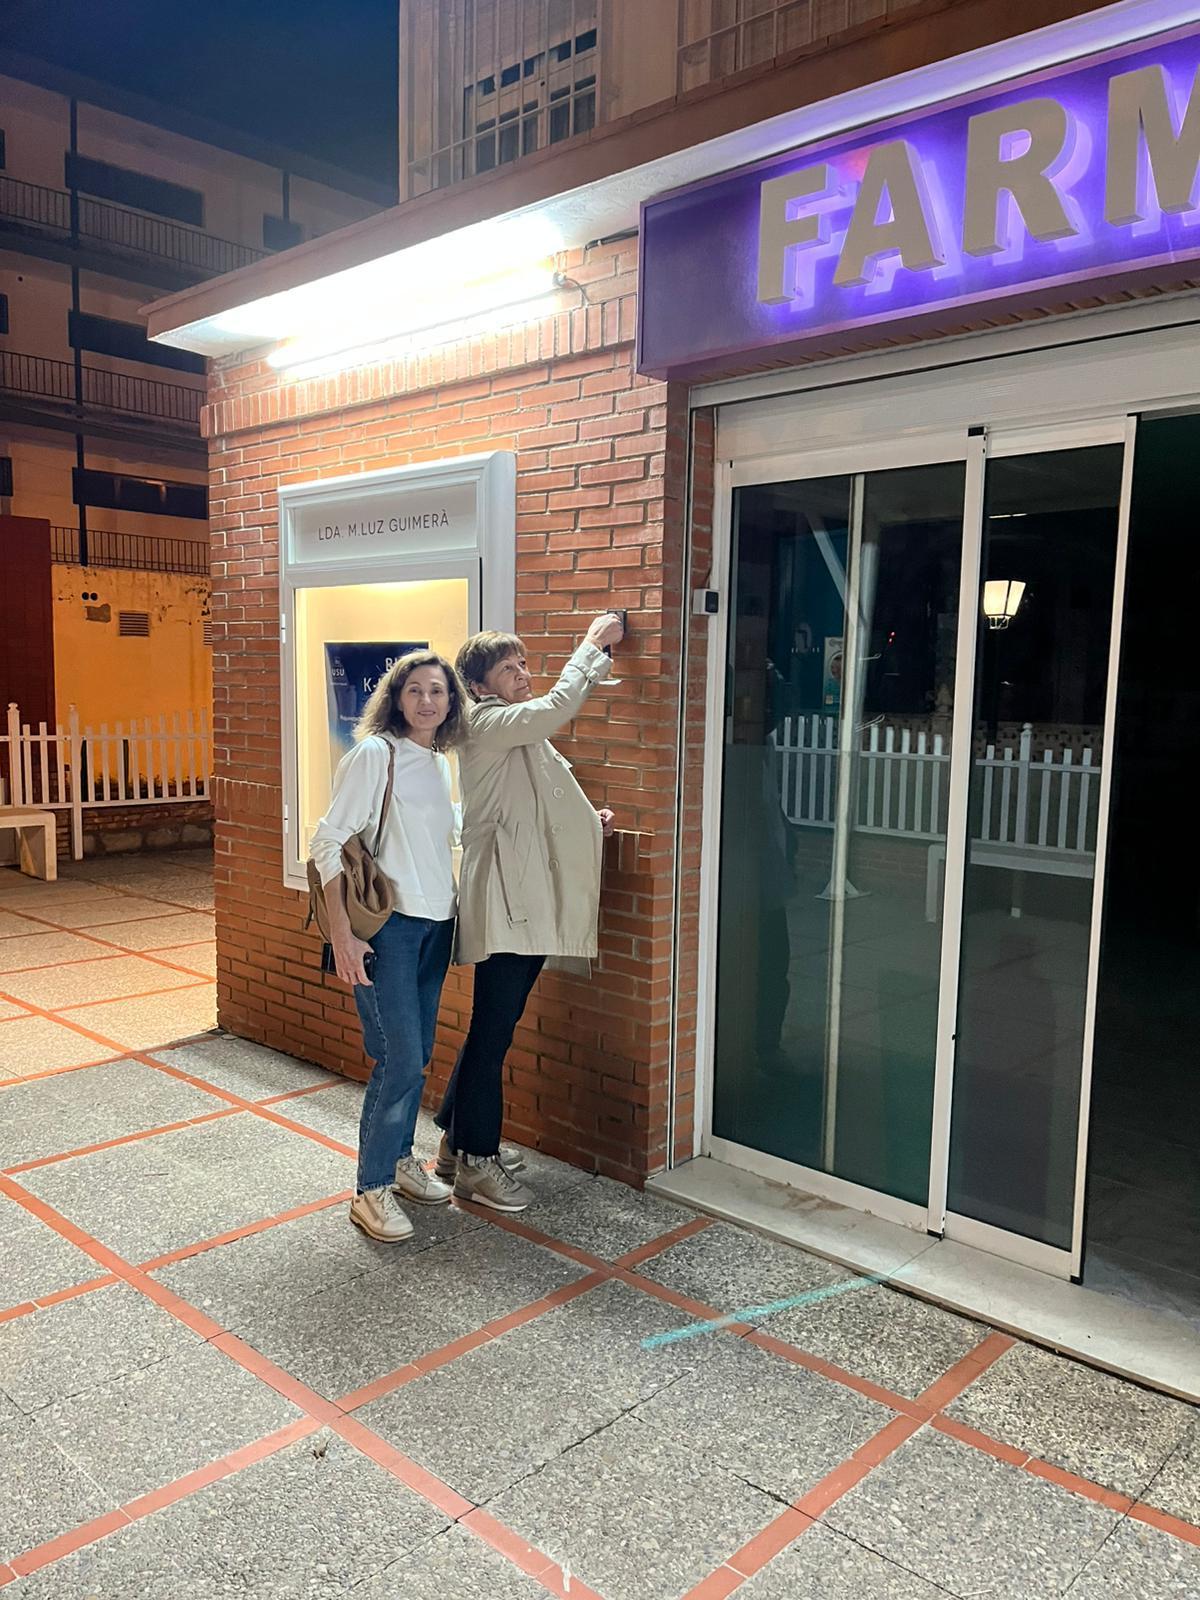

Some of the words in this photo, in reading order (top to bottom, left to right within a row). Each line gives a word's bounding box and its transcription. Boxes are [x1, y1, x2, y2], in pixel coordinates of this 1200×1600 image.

[757, 63, 1200, 306] FARM
[318, 525, 344, 541] LDA.
[348, 520, 385, 537] M.LUZ
[388, 508, 450, 533] GUIMERÀ
